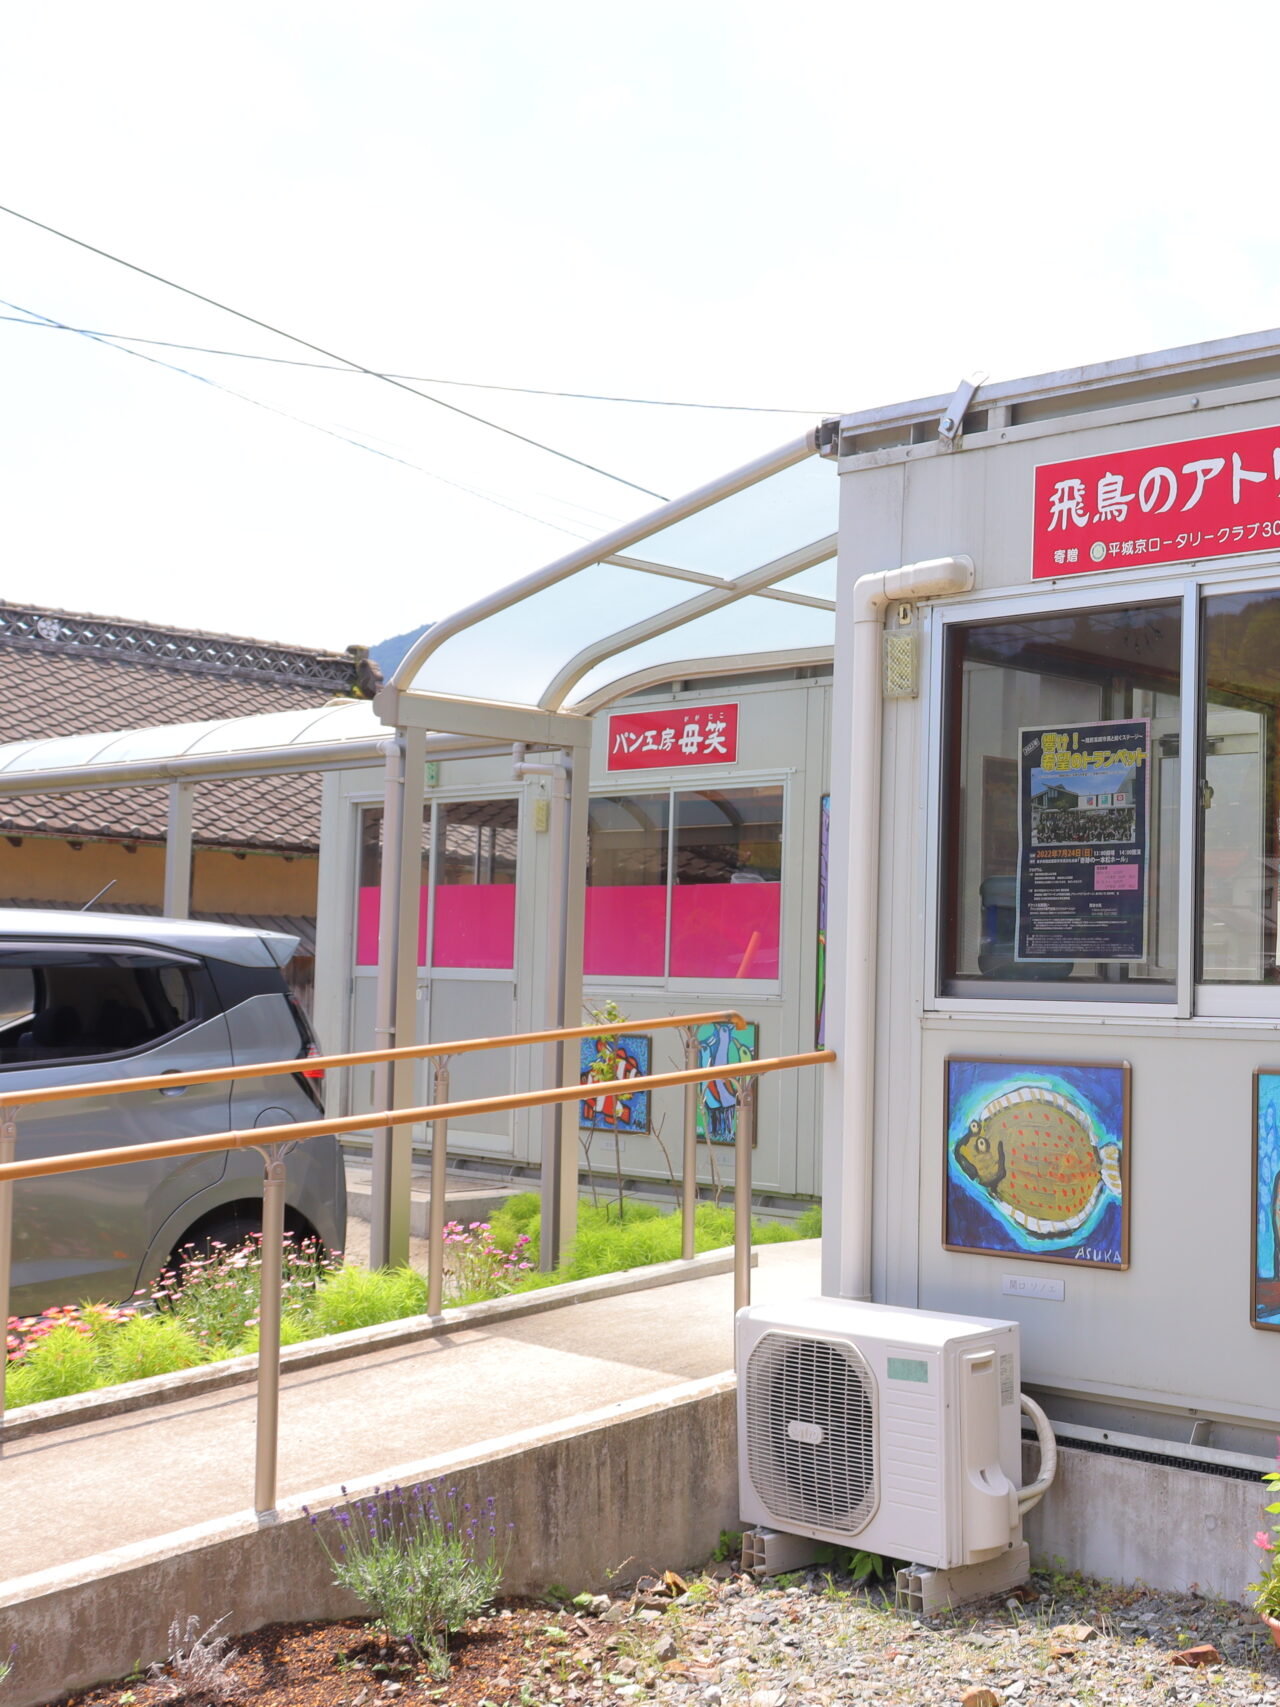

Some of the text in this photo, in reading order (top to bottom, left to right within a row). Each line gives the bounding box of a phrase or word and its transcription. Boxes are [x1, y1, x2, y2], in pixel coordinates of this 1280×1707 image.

[1053, 547, 1079, 565] 寄贈
[613, 728, 676, 755] パン工房
[1040, 747, 1149, 771] 希望のトランペット
[1074, 1247, 1122, 1263] ASUKA
